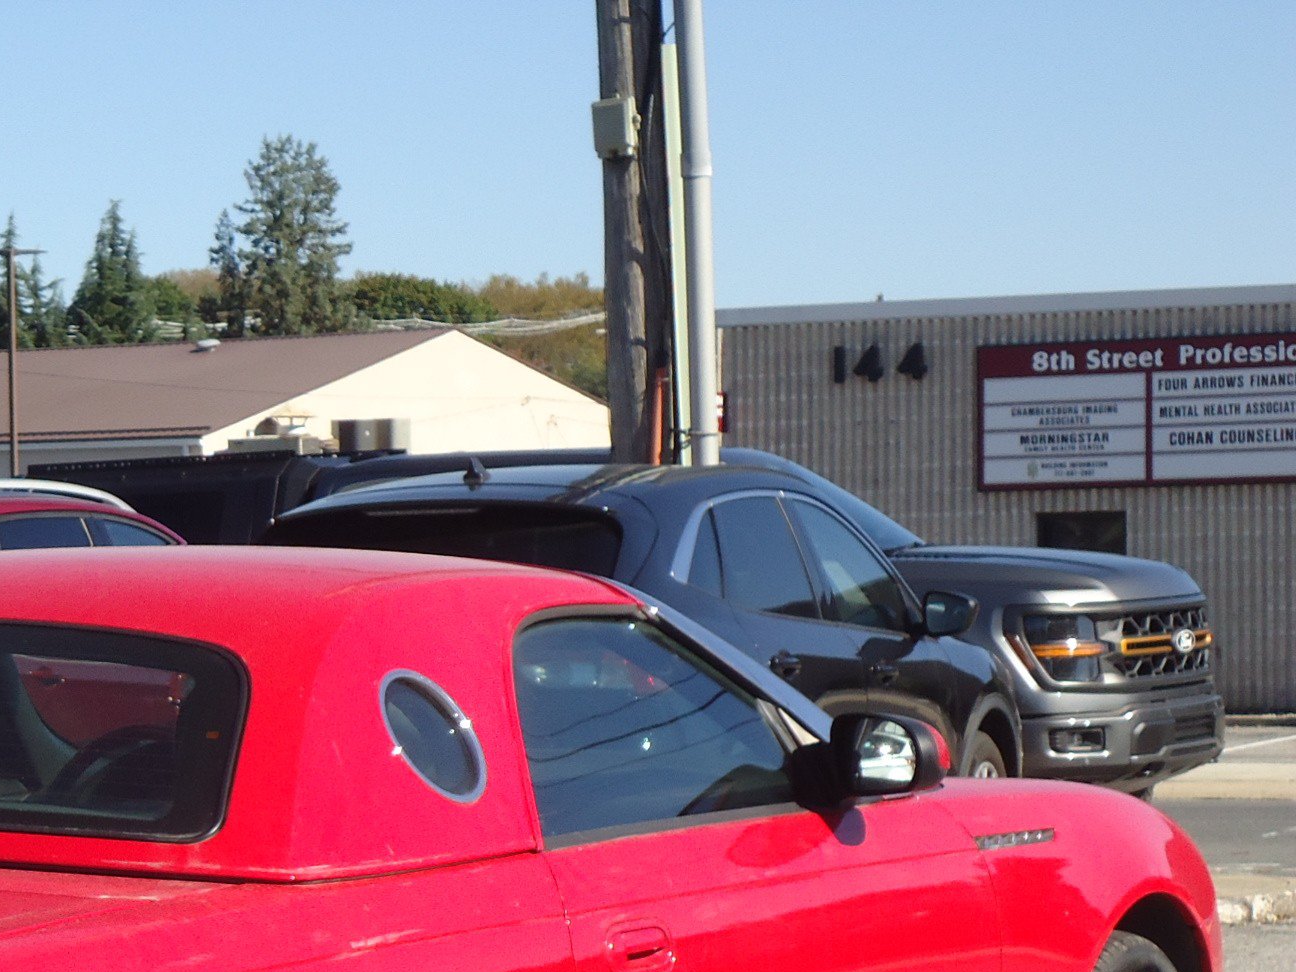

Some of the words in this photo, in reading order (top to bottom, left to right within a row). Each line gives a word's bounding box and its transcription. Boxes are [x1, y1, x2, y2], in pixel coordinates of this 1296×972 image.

[833, 342, 928, 384] 144
[1031, 350, 1075, 372] 8th
[1086, 347, 1163, 371] Street
[1157, 377, 1188, 392] FOUR
[1193, 374, 1244, 390] ARROWS
[1158, 405, 1199, 419] MENTAL
[1203, 403, 1241, 417] HEALTH
[1039, 415, 1090, 426] ASSOCIATES
[1020, 432, 1110, 445] MORNINGSTAR
[1169, 430, 1214, 447] COHAN
[1219, 428, 1296, 445] COUNSELIN
